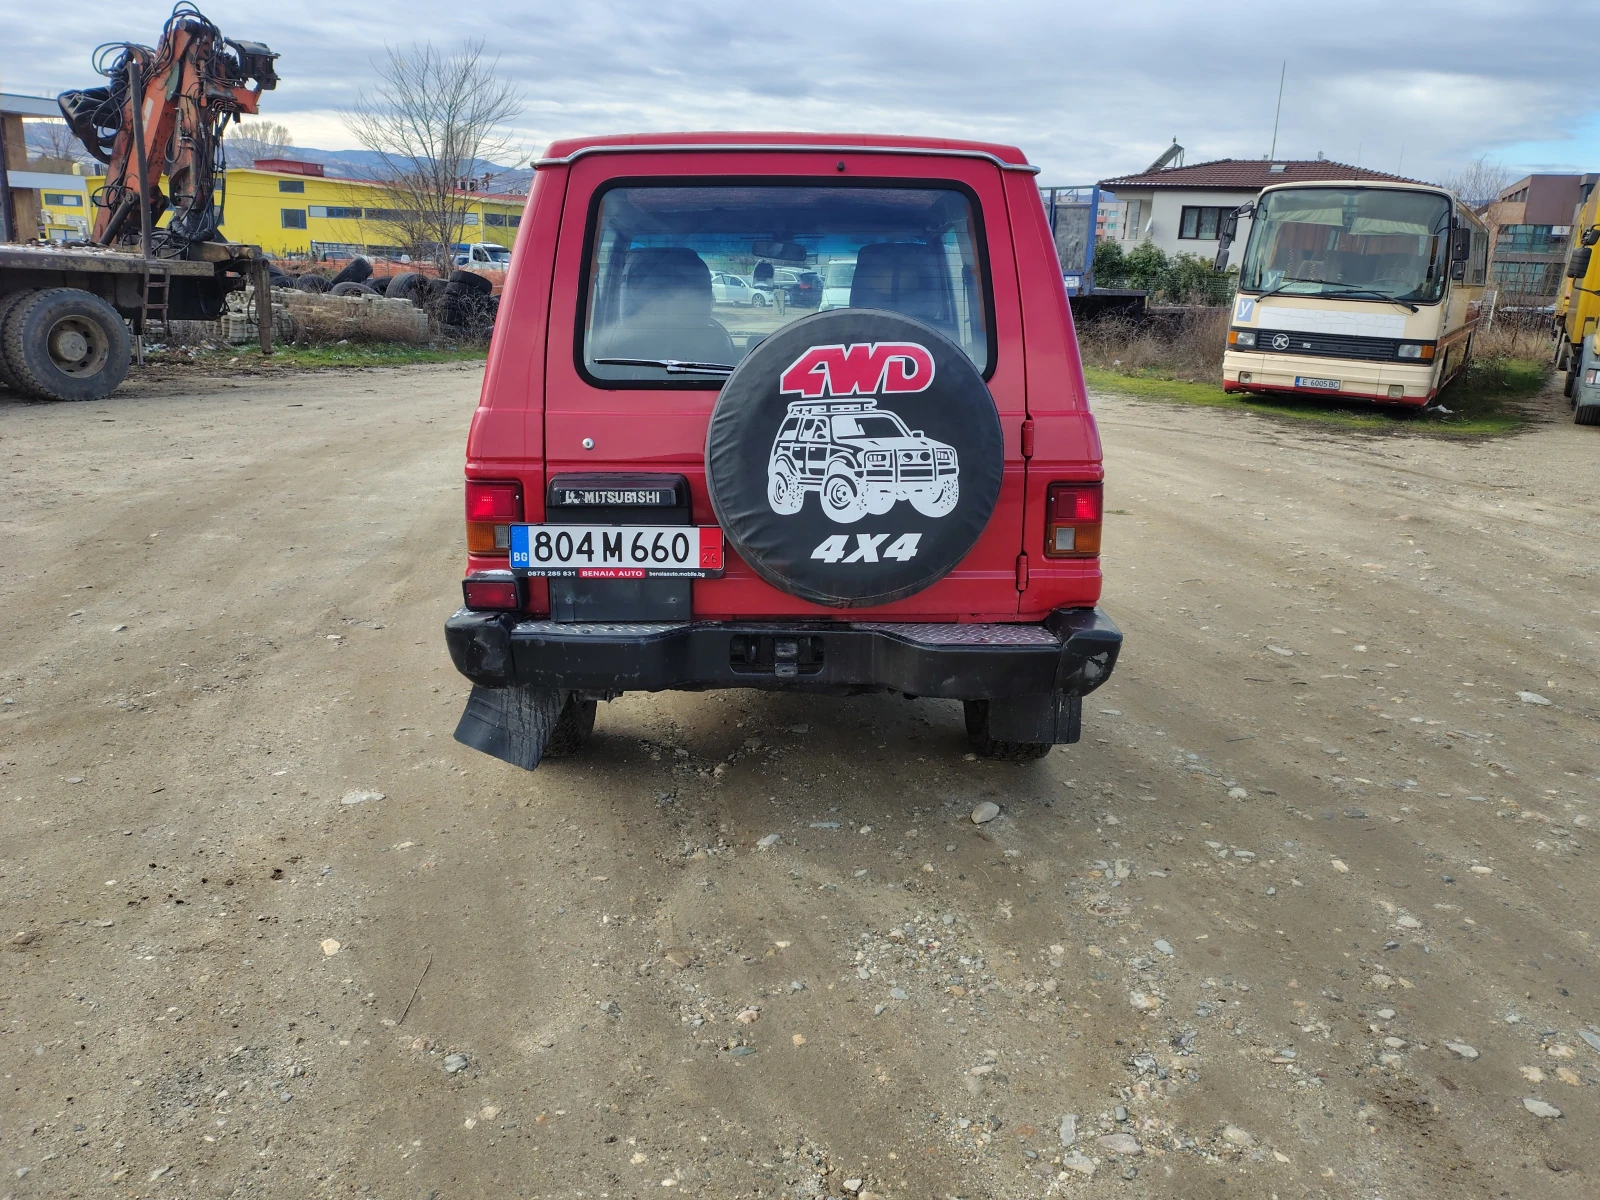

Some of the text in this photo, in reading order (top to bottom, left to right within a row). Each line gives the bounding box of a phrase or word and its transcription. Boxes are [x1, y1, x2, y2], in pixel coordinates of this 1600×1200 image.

[780, 341, 935, 398] 4WD
[1310, 380, 1328, 388] 6005
[584, 490, 660, 504] MITSUBISHI
[513, 531, 690, 563] BG 804 M 660
[702, 552, 717, 564] 26
[810, 533, 923, 563] 4X4
